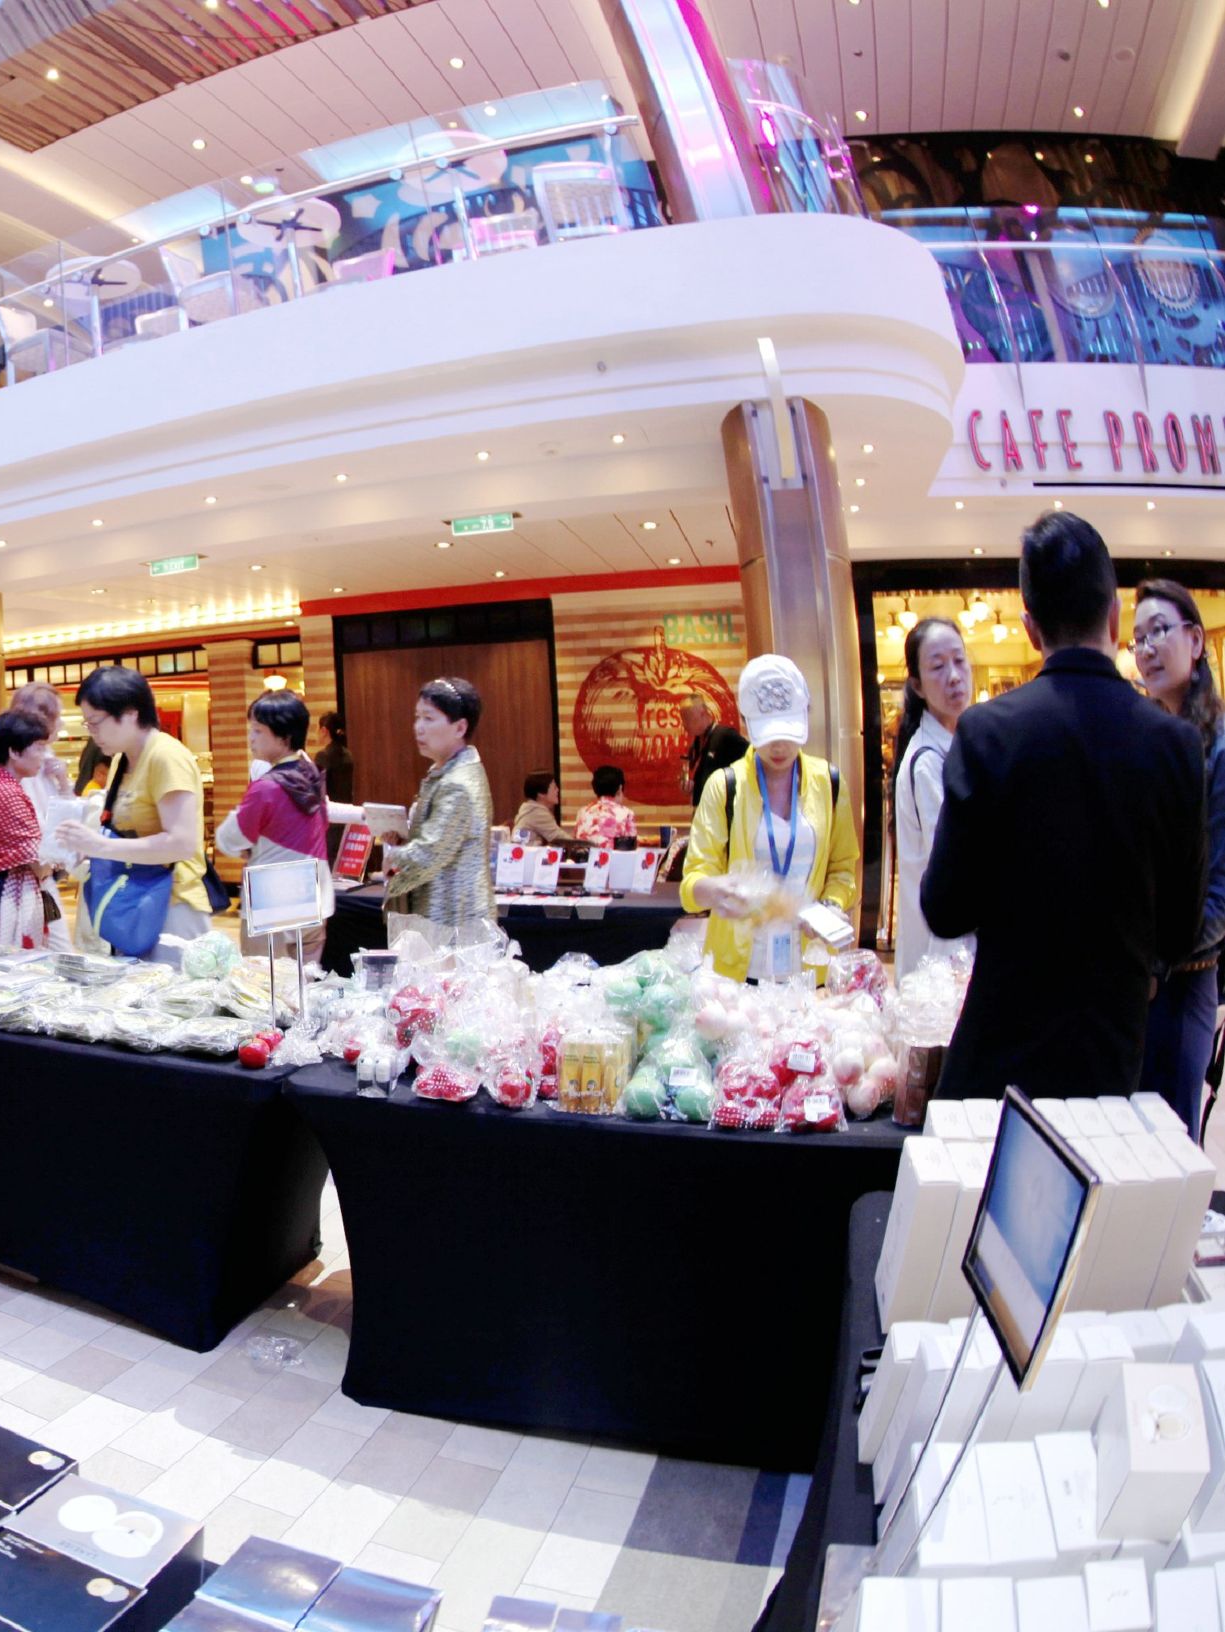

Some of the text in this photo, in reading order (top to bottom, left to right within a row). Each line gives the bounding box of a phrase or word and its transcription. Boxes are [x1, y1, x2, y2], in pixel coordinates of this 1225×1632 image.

[968, 407, 1225, 476] CAFE PROM
[663, 608, 740, 644] BASIL
